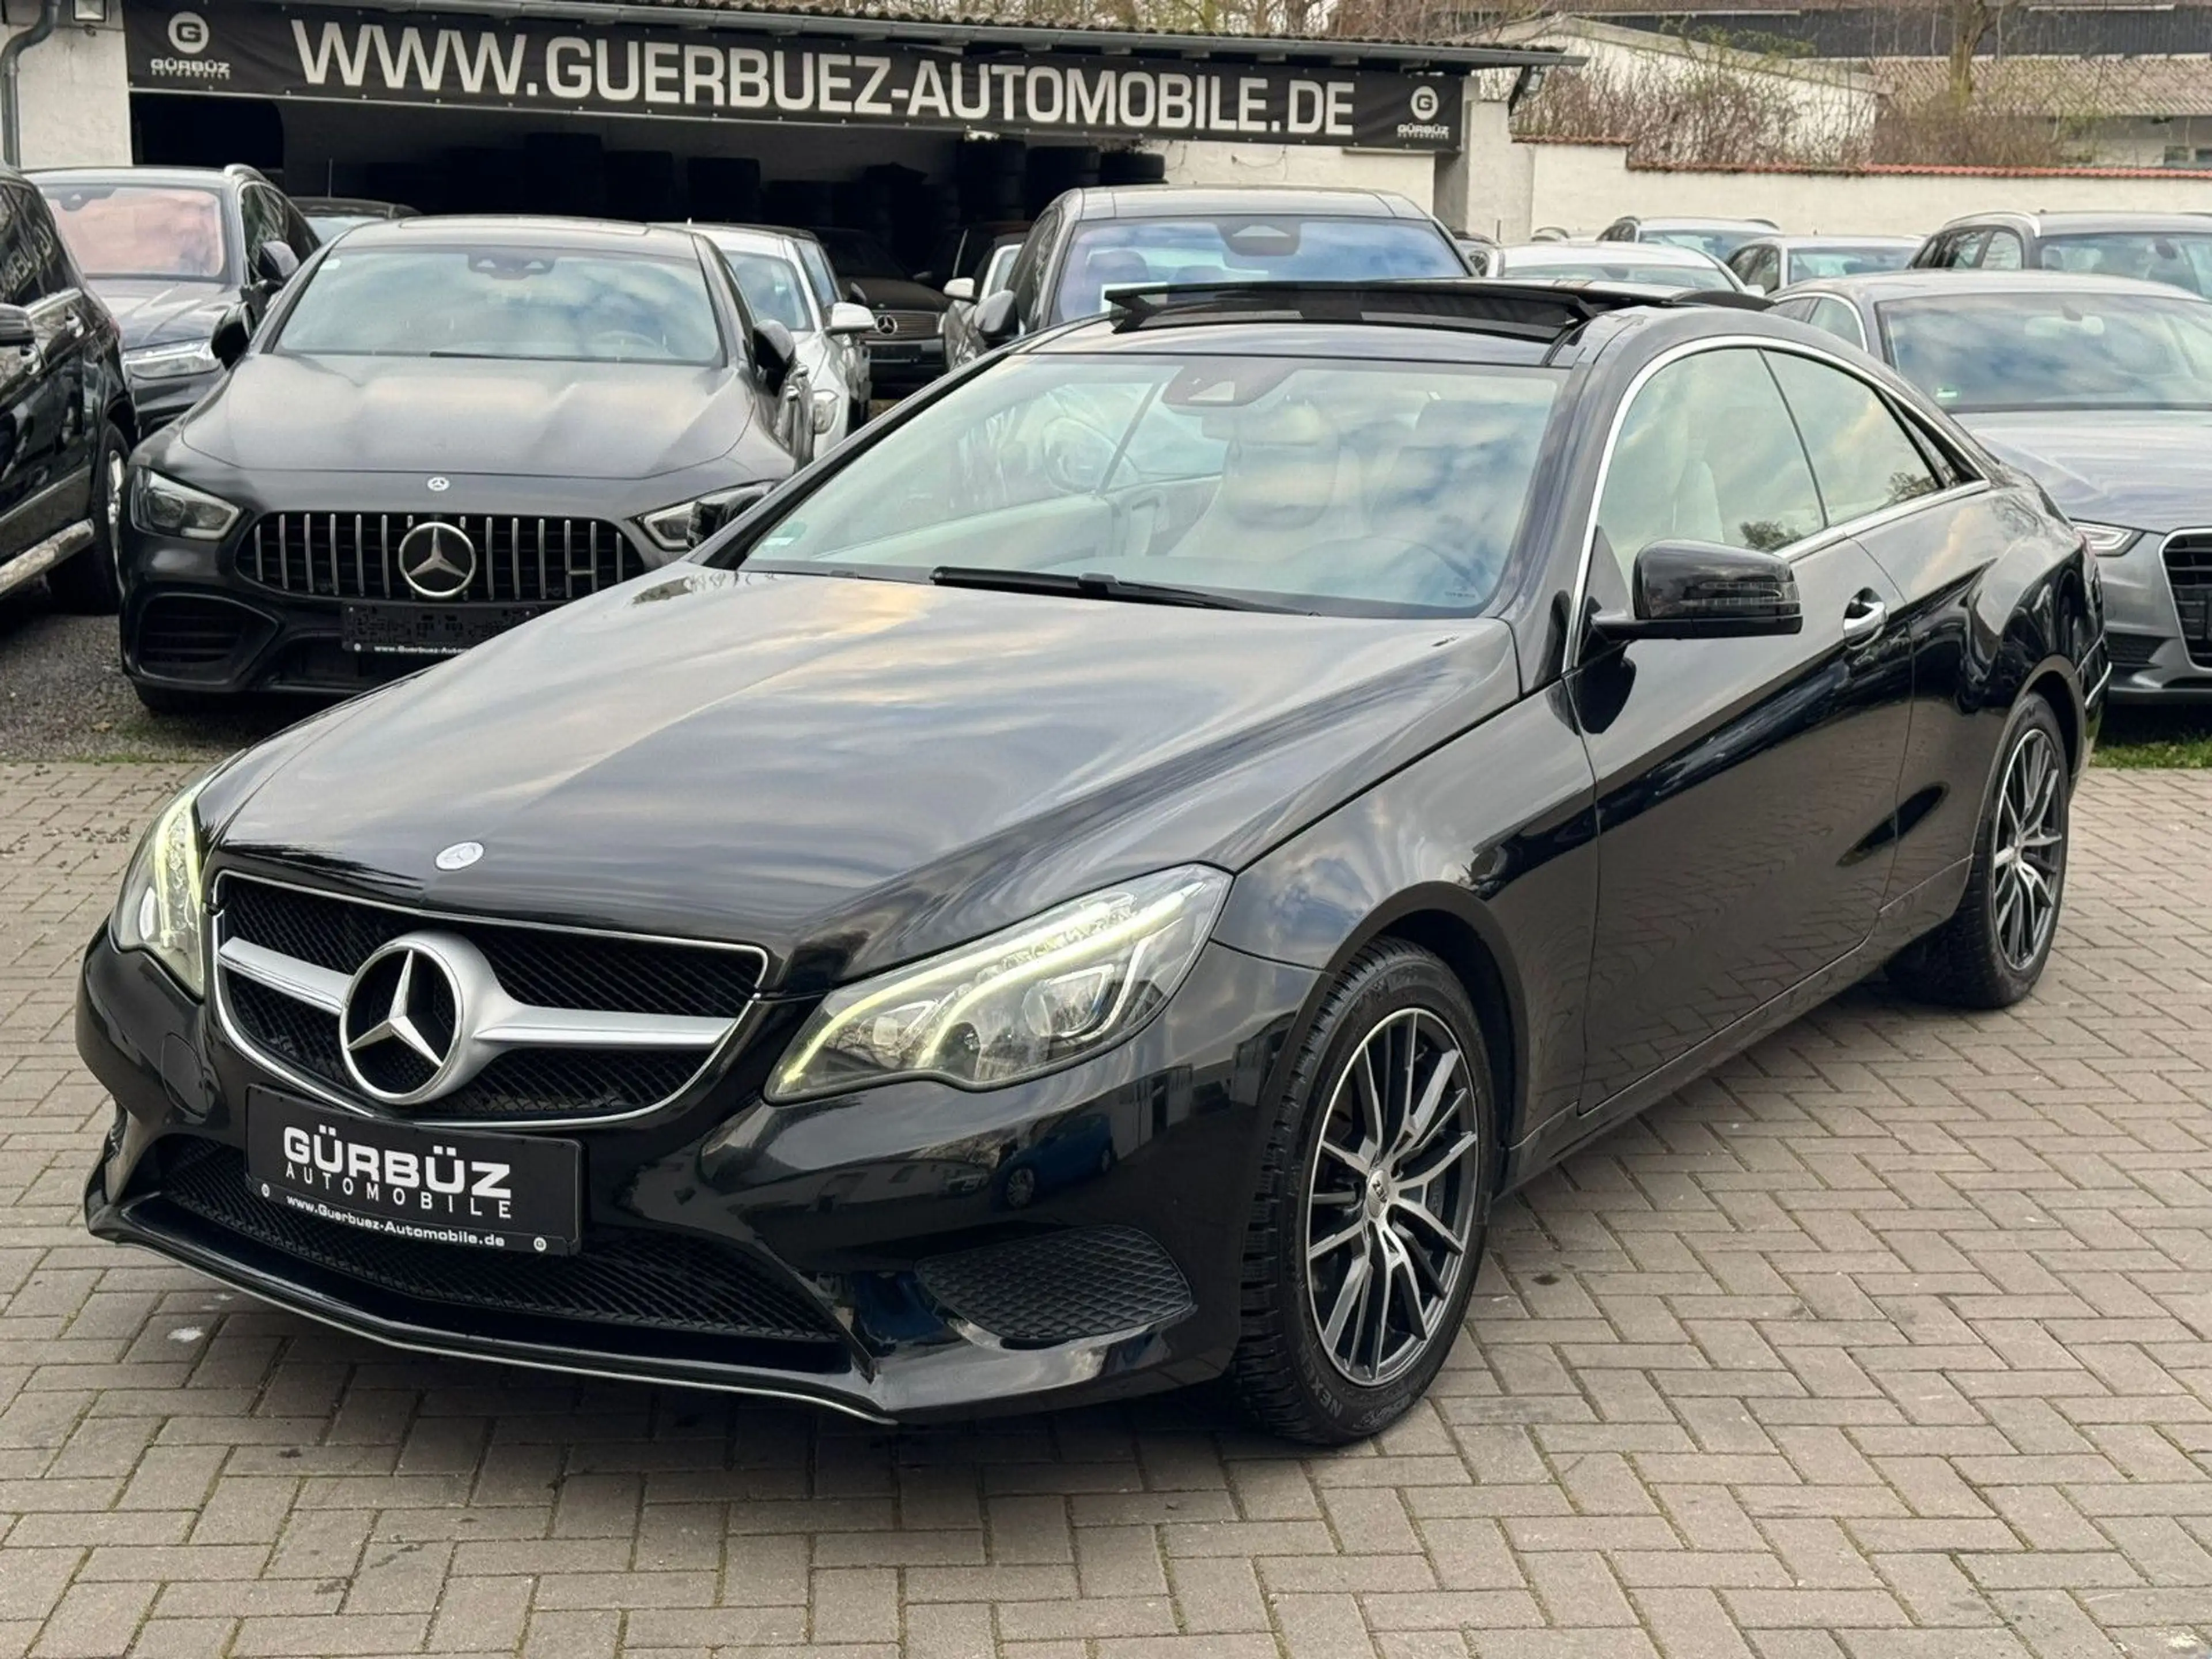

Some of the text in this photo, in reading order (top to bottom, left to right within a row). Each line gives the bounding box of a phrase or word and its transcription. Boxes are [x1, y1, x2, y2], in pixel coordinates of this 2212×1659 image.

[292, 19, 1354, 136] WWW.GUERBUEZ-AUTOMOBILE.DE
[284, 1124, 511, 1198] GÜRBÜZ
[286, 1161, 511, 1218] AUTOMOBILE
[286, 1195, 505, 1247] www.Guerbuez-Automobile.de
